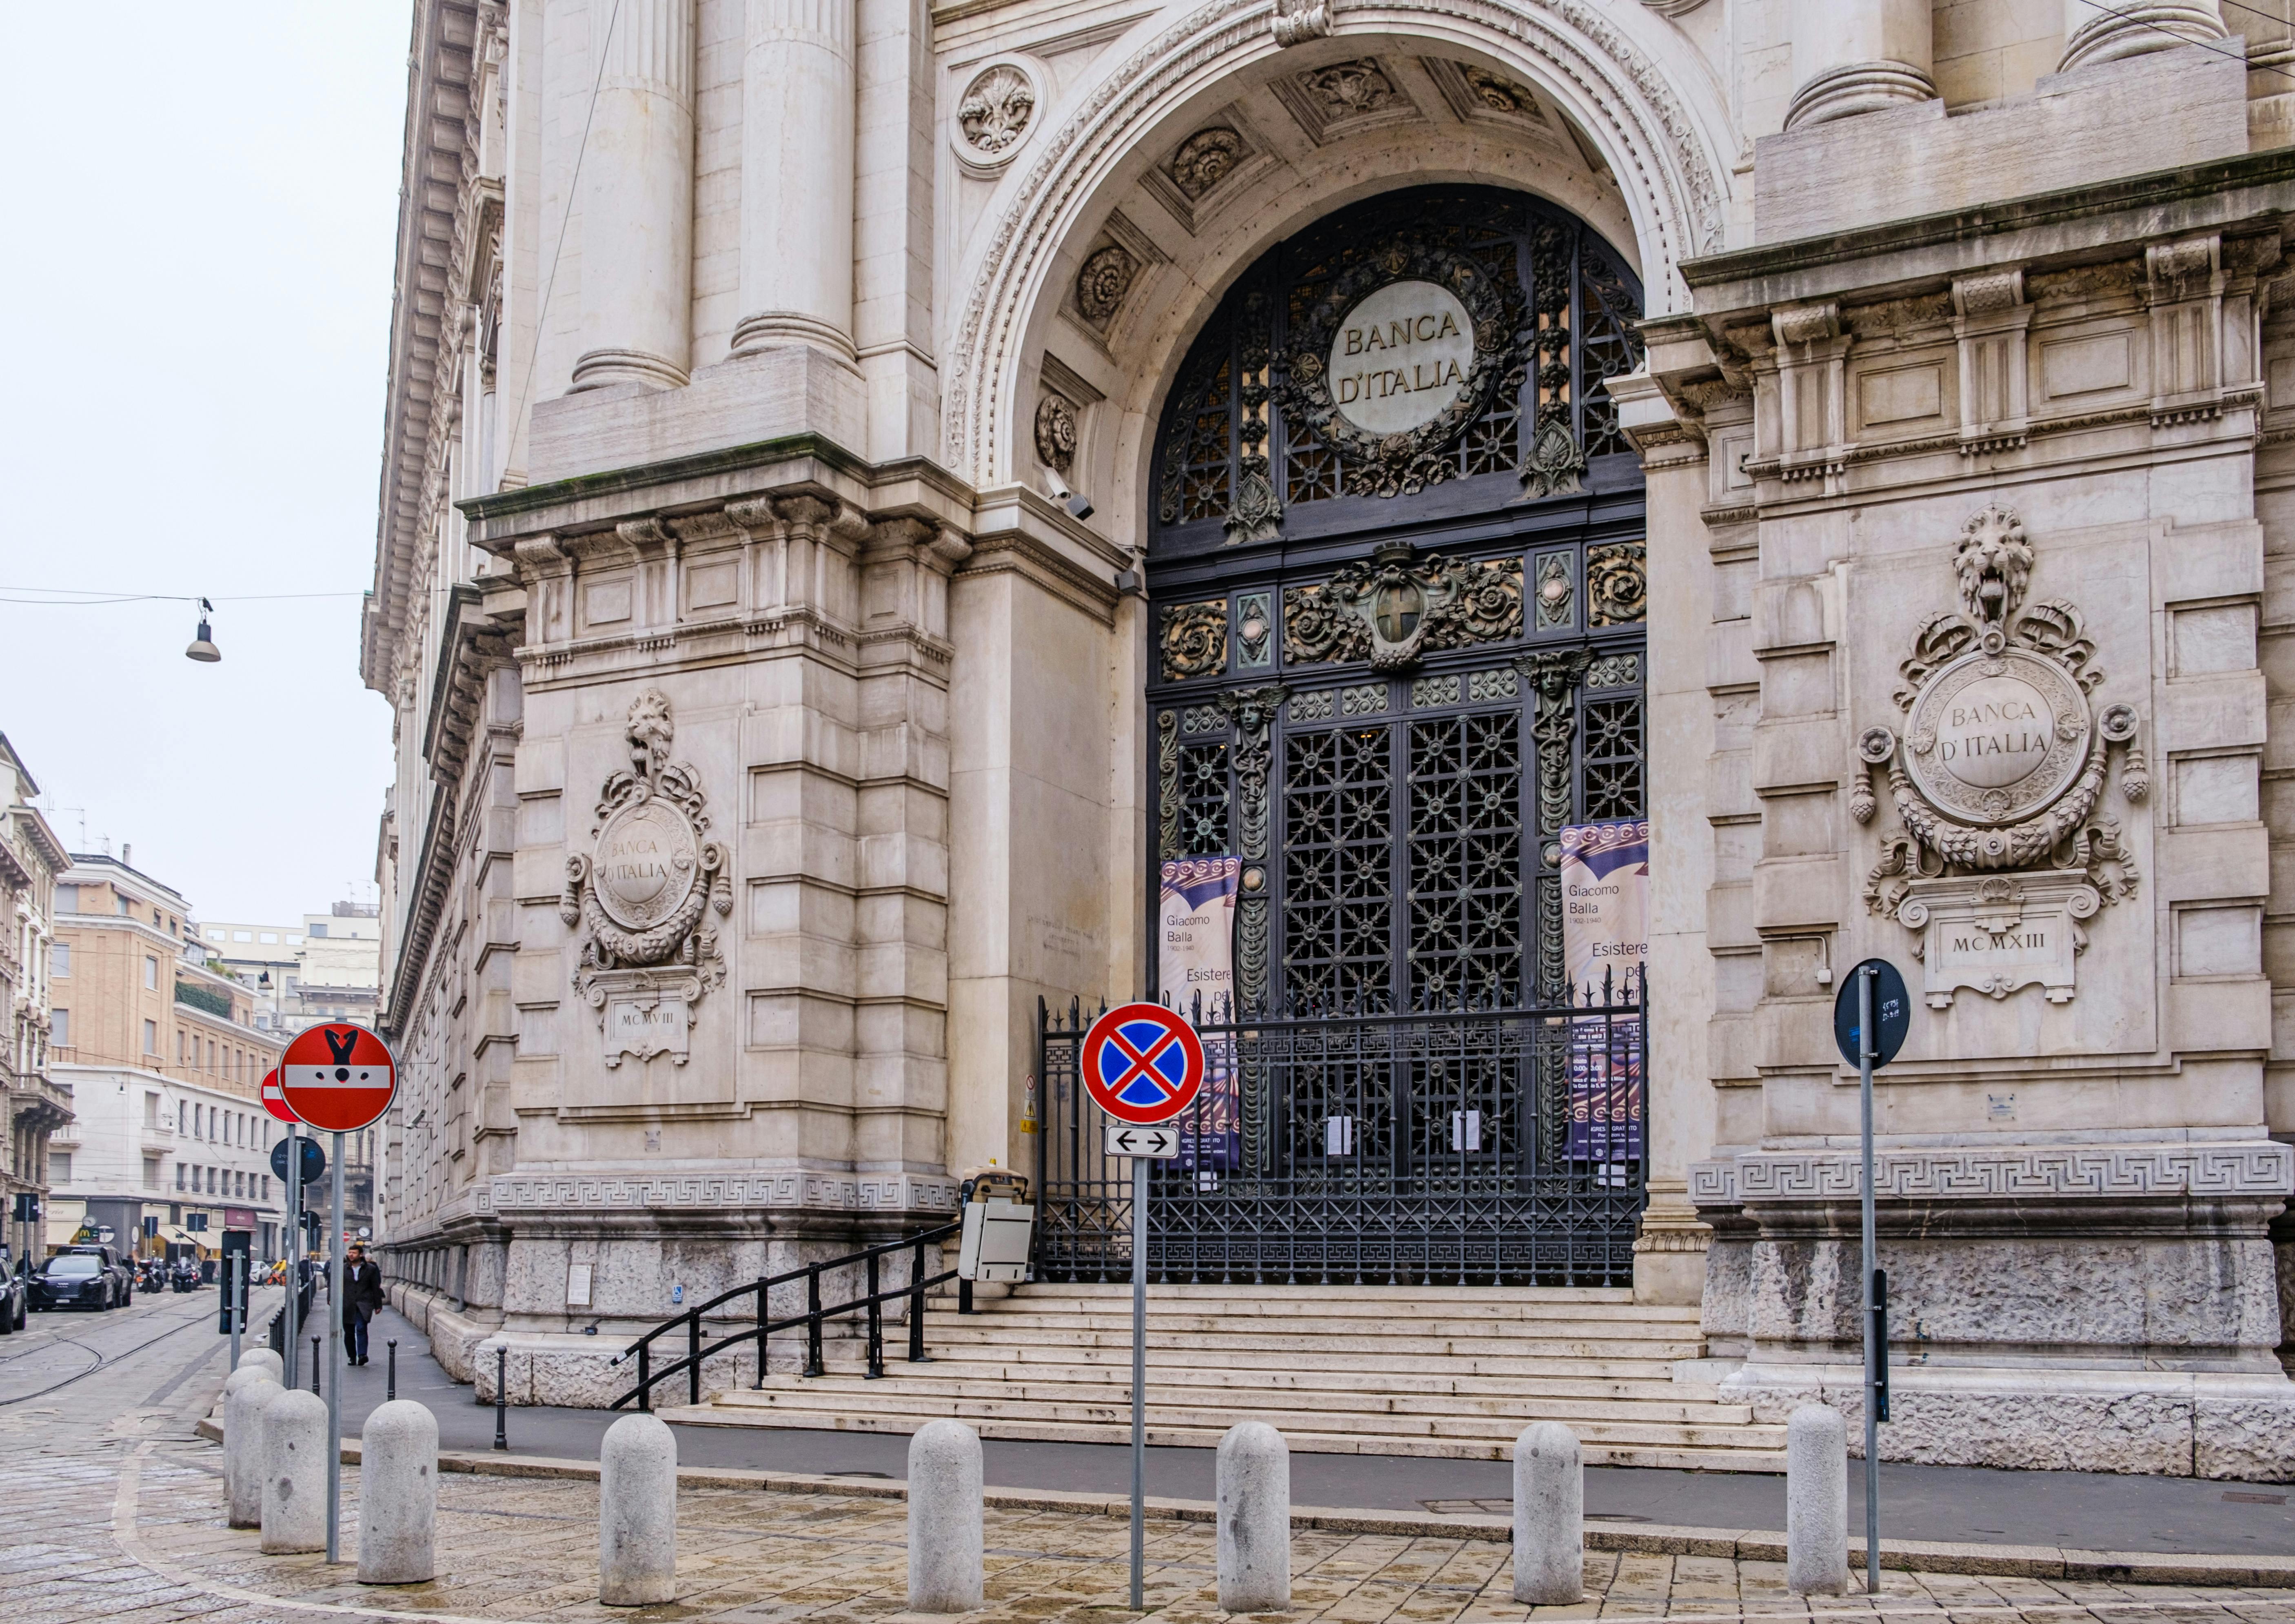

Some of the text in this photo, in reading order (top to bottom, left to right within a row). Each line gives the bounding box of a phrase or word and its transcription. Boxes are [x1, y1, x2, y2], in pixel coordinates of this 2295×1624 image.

[1344, 311, 1460, 355] BANCA
[1338, 358, 1465, 404] D'ITALIA
[1952, 702, 2035, 727] BANCA
[612, 840, 658, 857] BANCA
[1569, 884, 1619, 897] Giacomo
[1569, 902, 1598, 914] Balla
[1167, 914, 1210, 926] Giacomo
[1167, 932, 1192, 942] Balla
[1953, 933, 2045, 952] MCMXIII
[1592, 941, 1648, 957] Esistere
[1187, 967, 1231, 982] Esistere
[621, 1013, 673, 1026] MCMVIII
